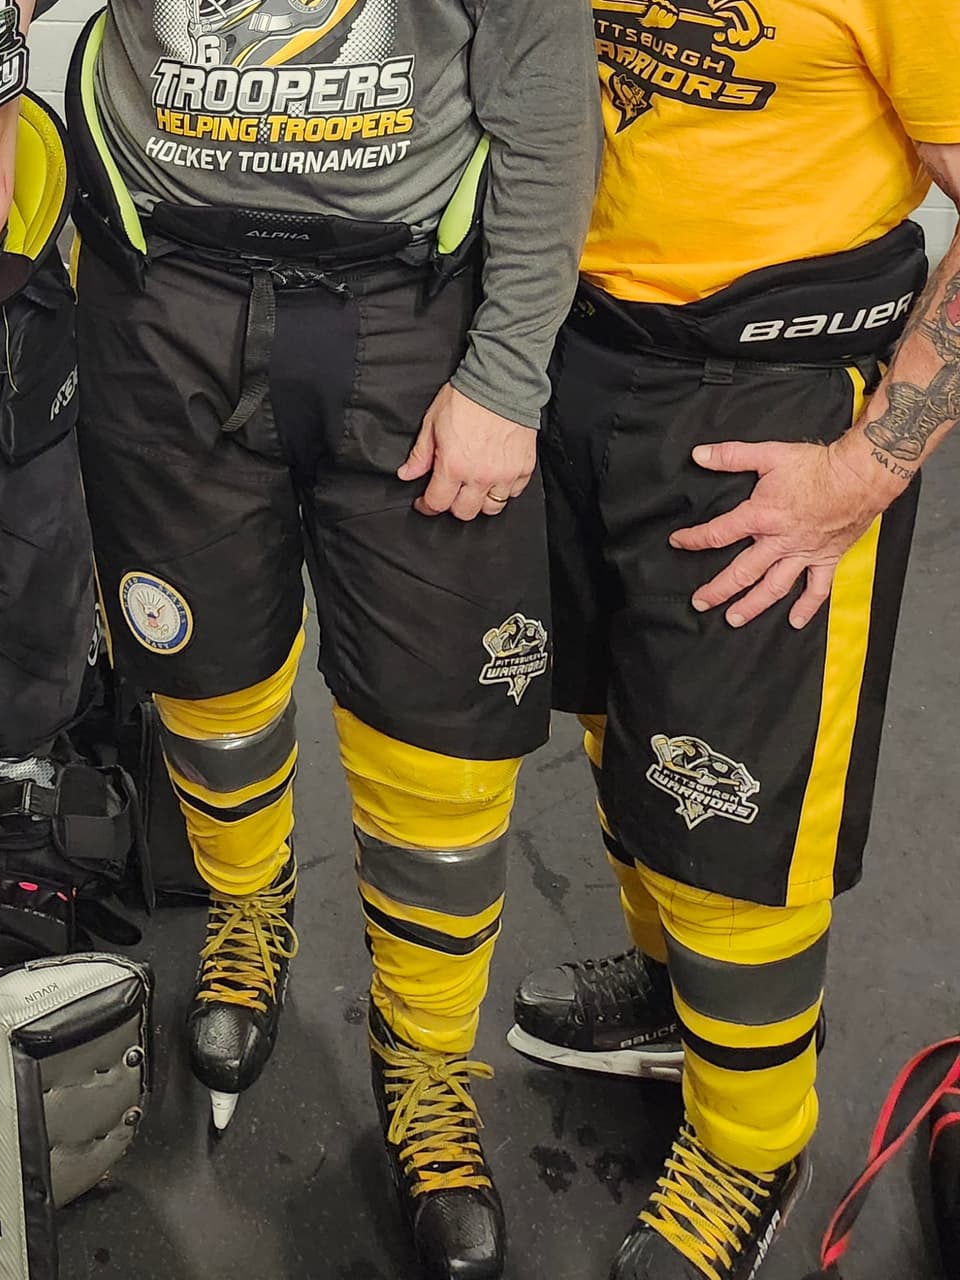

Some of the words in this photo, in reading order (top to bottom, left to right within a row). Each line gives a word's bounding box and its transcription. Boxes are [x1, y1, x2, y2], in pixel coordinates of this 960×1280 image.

[597, 19, 726, 74] TTSBURGH
[152, 57, 414, 114] TROOPERS
[596, 39, 764, 106] ARRIORS
[155, 107, 259, 143] HELPING
[267, 108, 416, 143] TROOPERS
[145, 137, 232, 171] HOCKEY
[237, 140, 412, 175] TOURNAMENT
[245, 229, 311, 242] ALPHA
[485, 658, 545, 679] WARRIORS
[652, 769, 752, 817] WARRIORS
